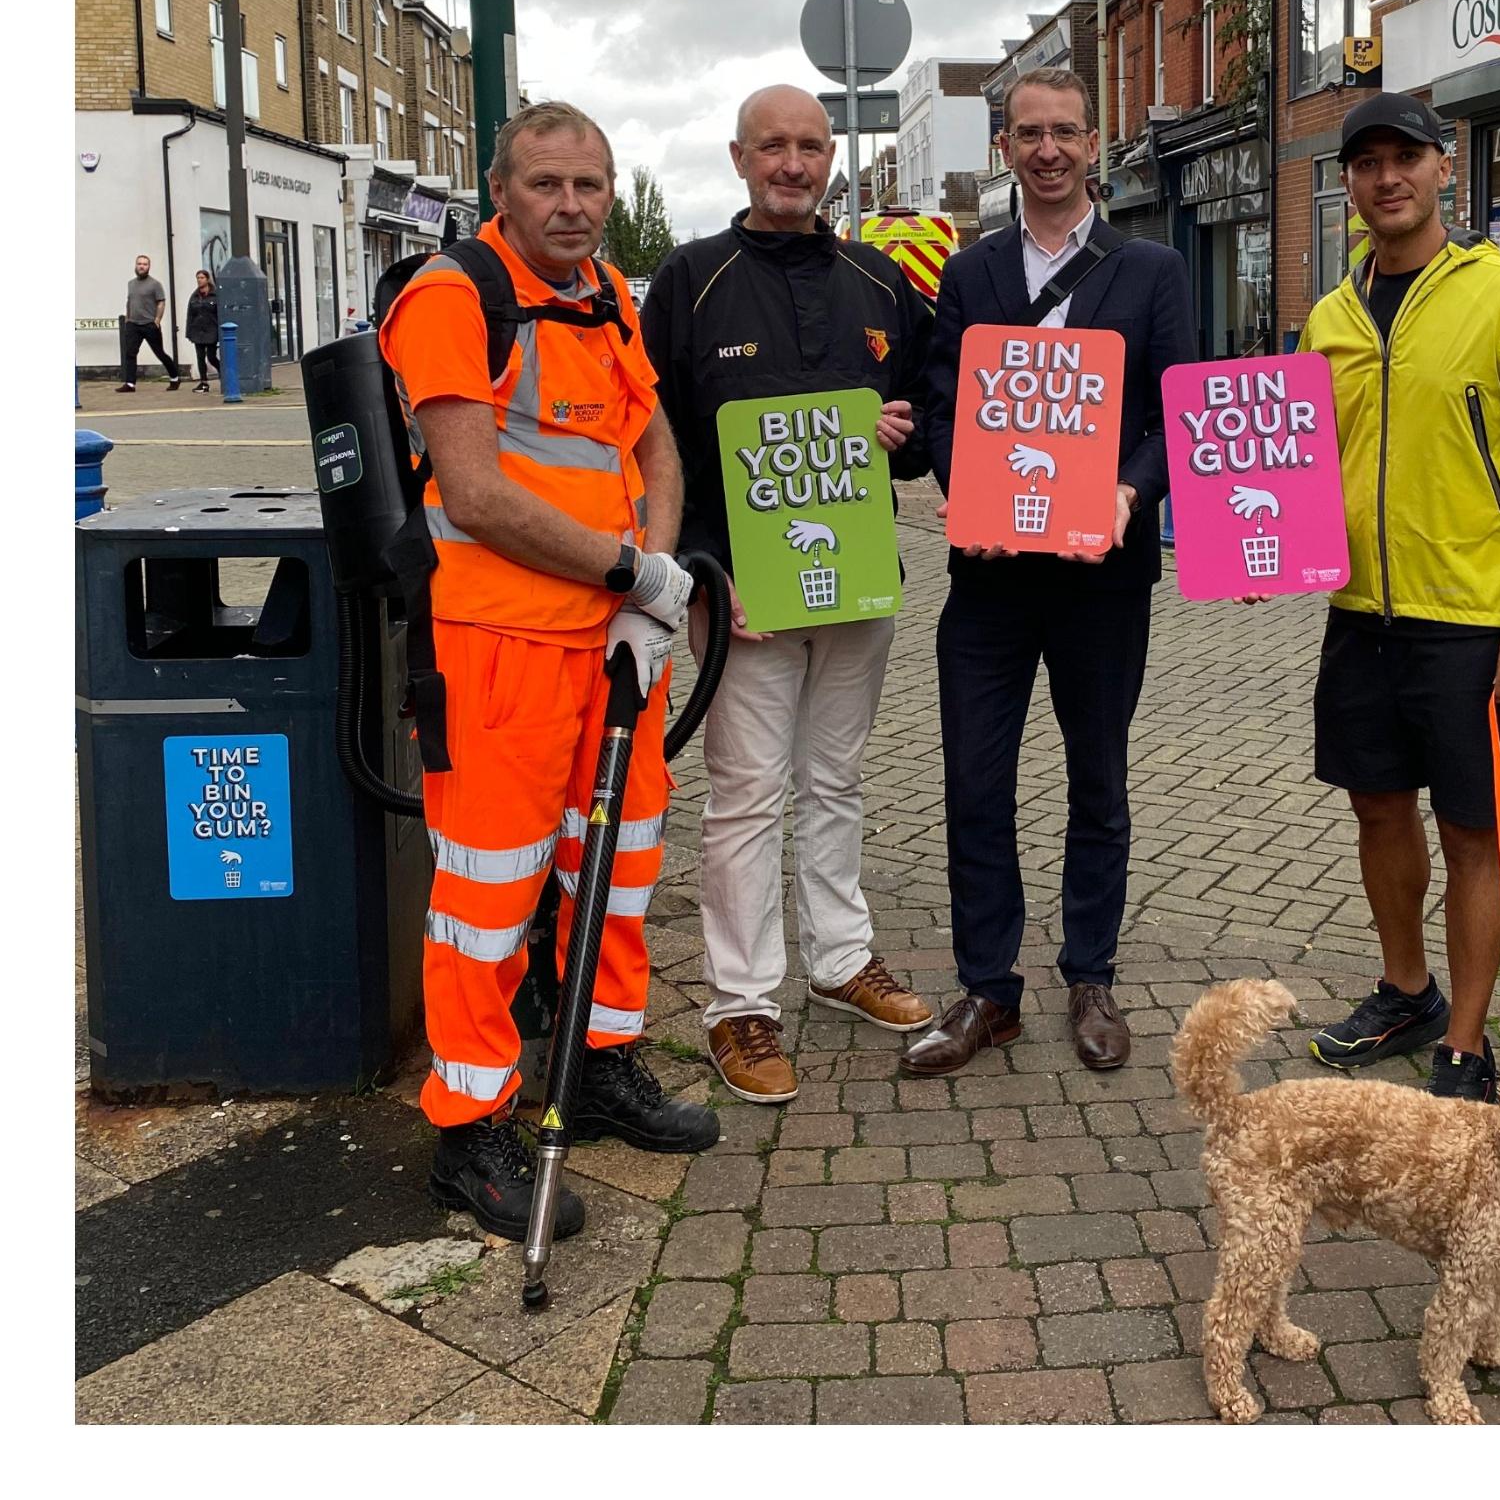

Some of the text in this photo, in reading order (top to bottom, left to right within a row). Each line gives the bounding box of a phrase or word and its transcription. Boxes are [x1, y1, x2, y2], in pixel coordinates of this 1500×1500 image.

[1354, 53, 1367, 61] Pay
[80, 320, 115, 328] STREET
[1001, 339, 1081, 371] BIN
[974, 368, 1104, 404] YOUR
[1203, 370, 1286, 409] BIN
[759, 405, 840, 445] BIN
[976, 400, 1096, 436] GUM.
[1179, 401, 1316, 443] YOUR
[329, 448, 356, 462] REMOVAL
[735, 436, 870, 480] YOUR
[1189, 435, 1314, 475] GUM.
[747, 470, 868, 511] GUM.
[191, 747, 260, 767] TIME
[207, 765, 245, 784] TO
[203, 784, 251, 802] BIN
[188, 801, 267, 820] YOUR
[194, 819, 272, 838] GUM?
